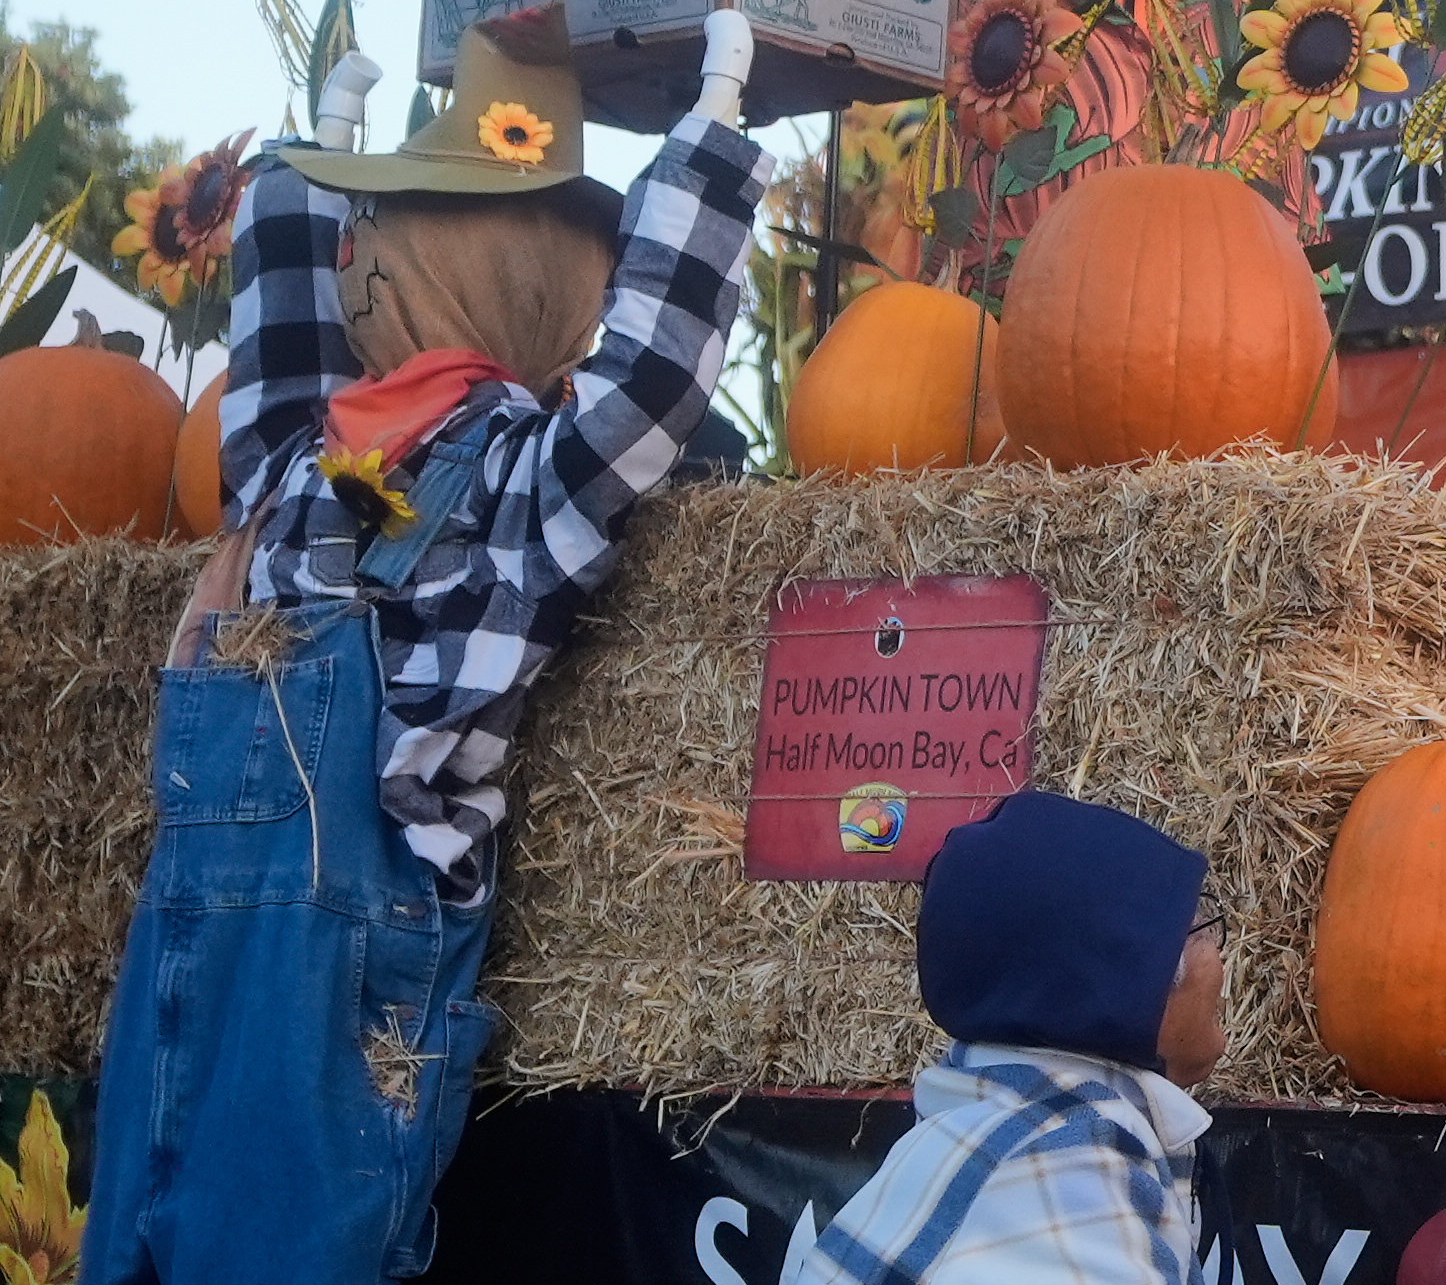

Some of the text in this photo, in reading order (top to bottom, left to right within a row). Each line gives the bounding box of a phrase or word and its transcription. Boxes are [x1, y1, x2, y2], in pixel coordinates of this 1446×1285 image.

[841, 12, 921, 43] GIUSTI FARMS
[773, 672, 1022, 716] PUMPKIN TOWN
[765, 729, 1018, 777] Half Moon Bay, Ca
